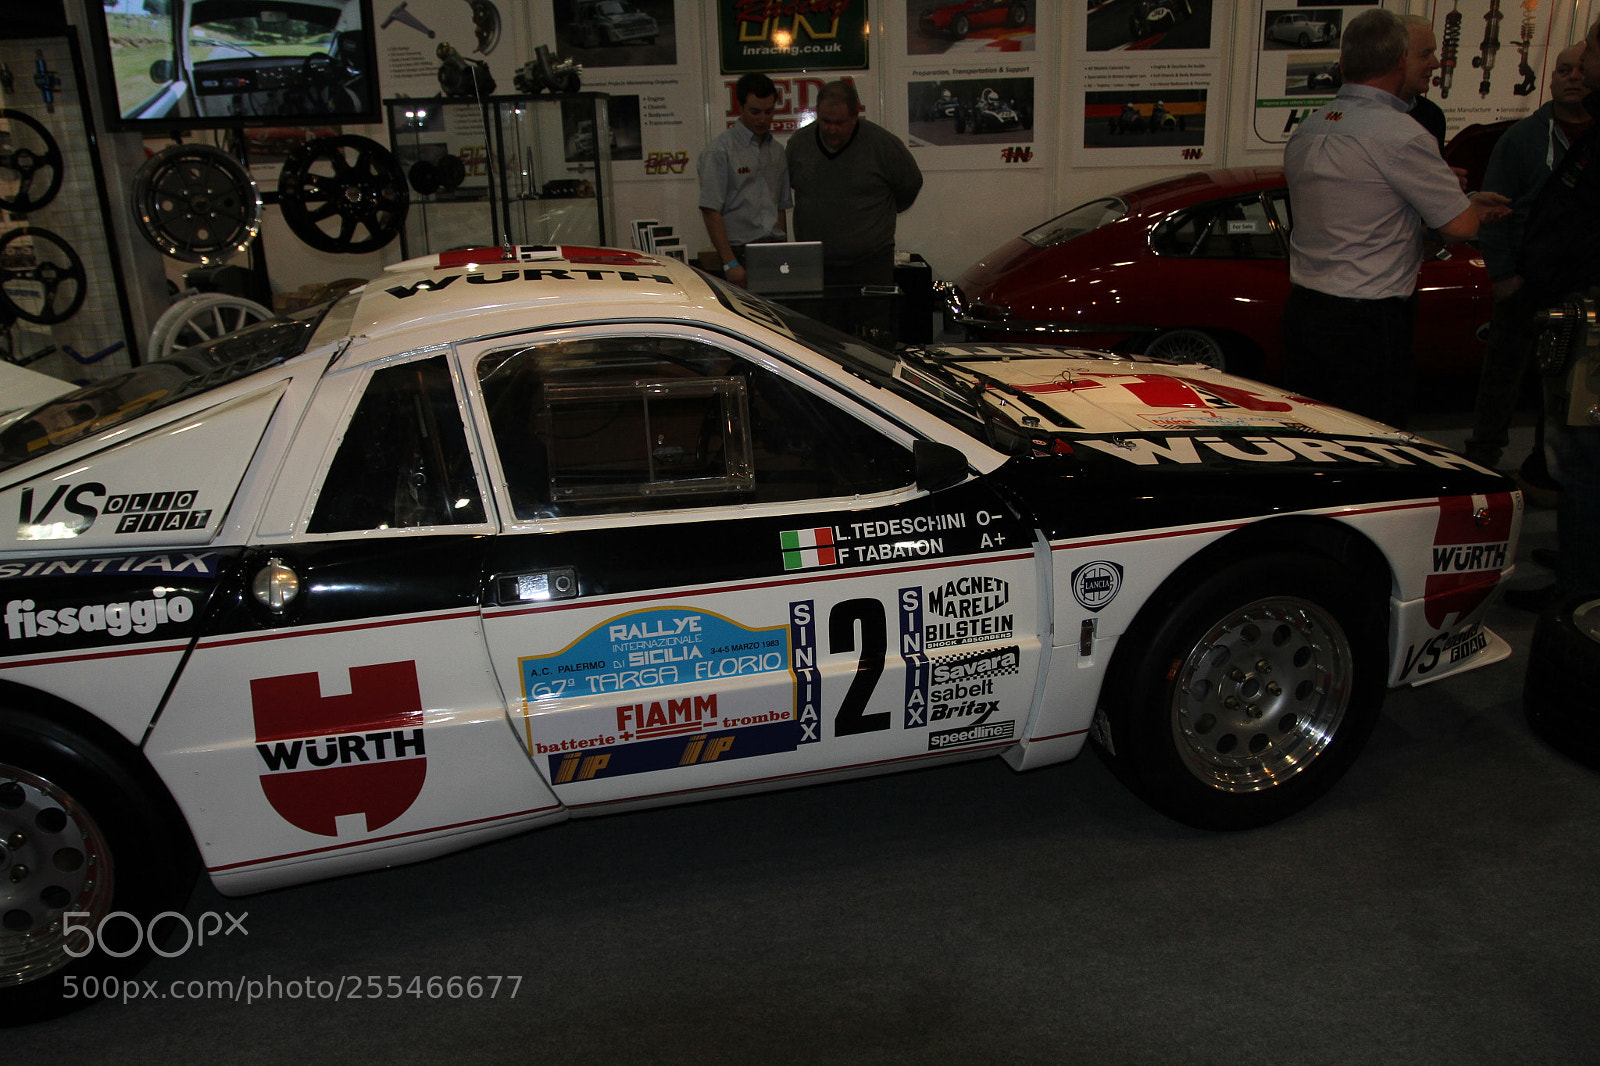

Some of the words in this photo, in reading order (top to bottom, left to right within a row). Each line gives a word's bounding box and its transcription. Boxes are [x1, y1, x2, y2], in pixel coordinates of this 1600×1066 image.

[743, 43, 842, 57] inracing.co.uk
[952, 67, 997, 76] Transportation
[1005, 66, 1030, 74] Support
[16, 482, 107, 541] VS
[104, 491, 195, 514] OLIO
[119, 510, 209, 532] FIAT
[857, 537, 944, 562] TABATON
[1432, 542, 1508, 573] WÜRTH
[0, 551, 217, 578] SINTIAX
[928, 576, 1009, 604] MAGNETI
[1085, 580, 1110, 590] LANCIA
[4, 586, 194, 640] fissaggio
[928, 595, 1009, 619] MARELLI
[609, 615, 702, 642] RALLYE
[925, 614, 1014, 642] BILSTEIN
[927, 640, 958, 649] SHOCK
[961, 632, 1012, 644] ABSORBERS
[612, 634, 703, 653] INTERNAZIONALE
[629, 645, 703, 667] SICILIA
[710, 646, 730, 655] 3-4-5
[731, 642, 760, 653] MARZO
[761, 639, 780, 649] 1983
[1399, 631, 1450, 681] VS
[1450, 632, 1487, 663] FIAT
[531, 667, 553, 677] A.C.
[558, 660, 606, 674] PALERMO
[828, 598, 891, 738] 2
[903, 590, 924, 726] SINTIAX
[934, 652, 1016, 683] Savara
[586, 666, 679, 693] TARGA
[695, 652, 782, 680] FLORIO
[793, 604, 820, 742] SINTIAX
[930, 680, 994, 703] sabelt
[616, 694, 718, 731] FIAMM
[930, 700, 1001, 726] Britax
[535, 732, 615, 755] batterie
[722, 709, 790, 729] trombe
[930, 725, 1004, 747] speedline
[255, 728, 426, 772] WÜRTH
